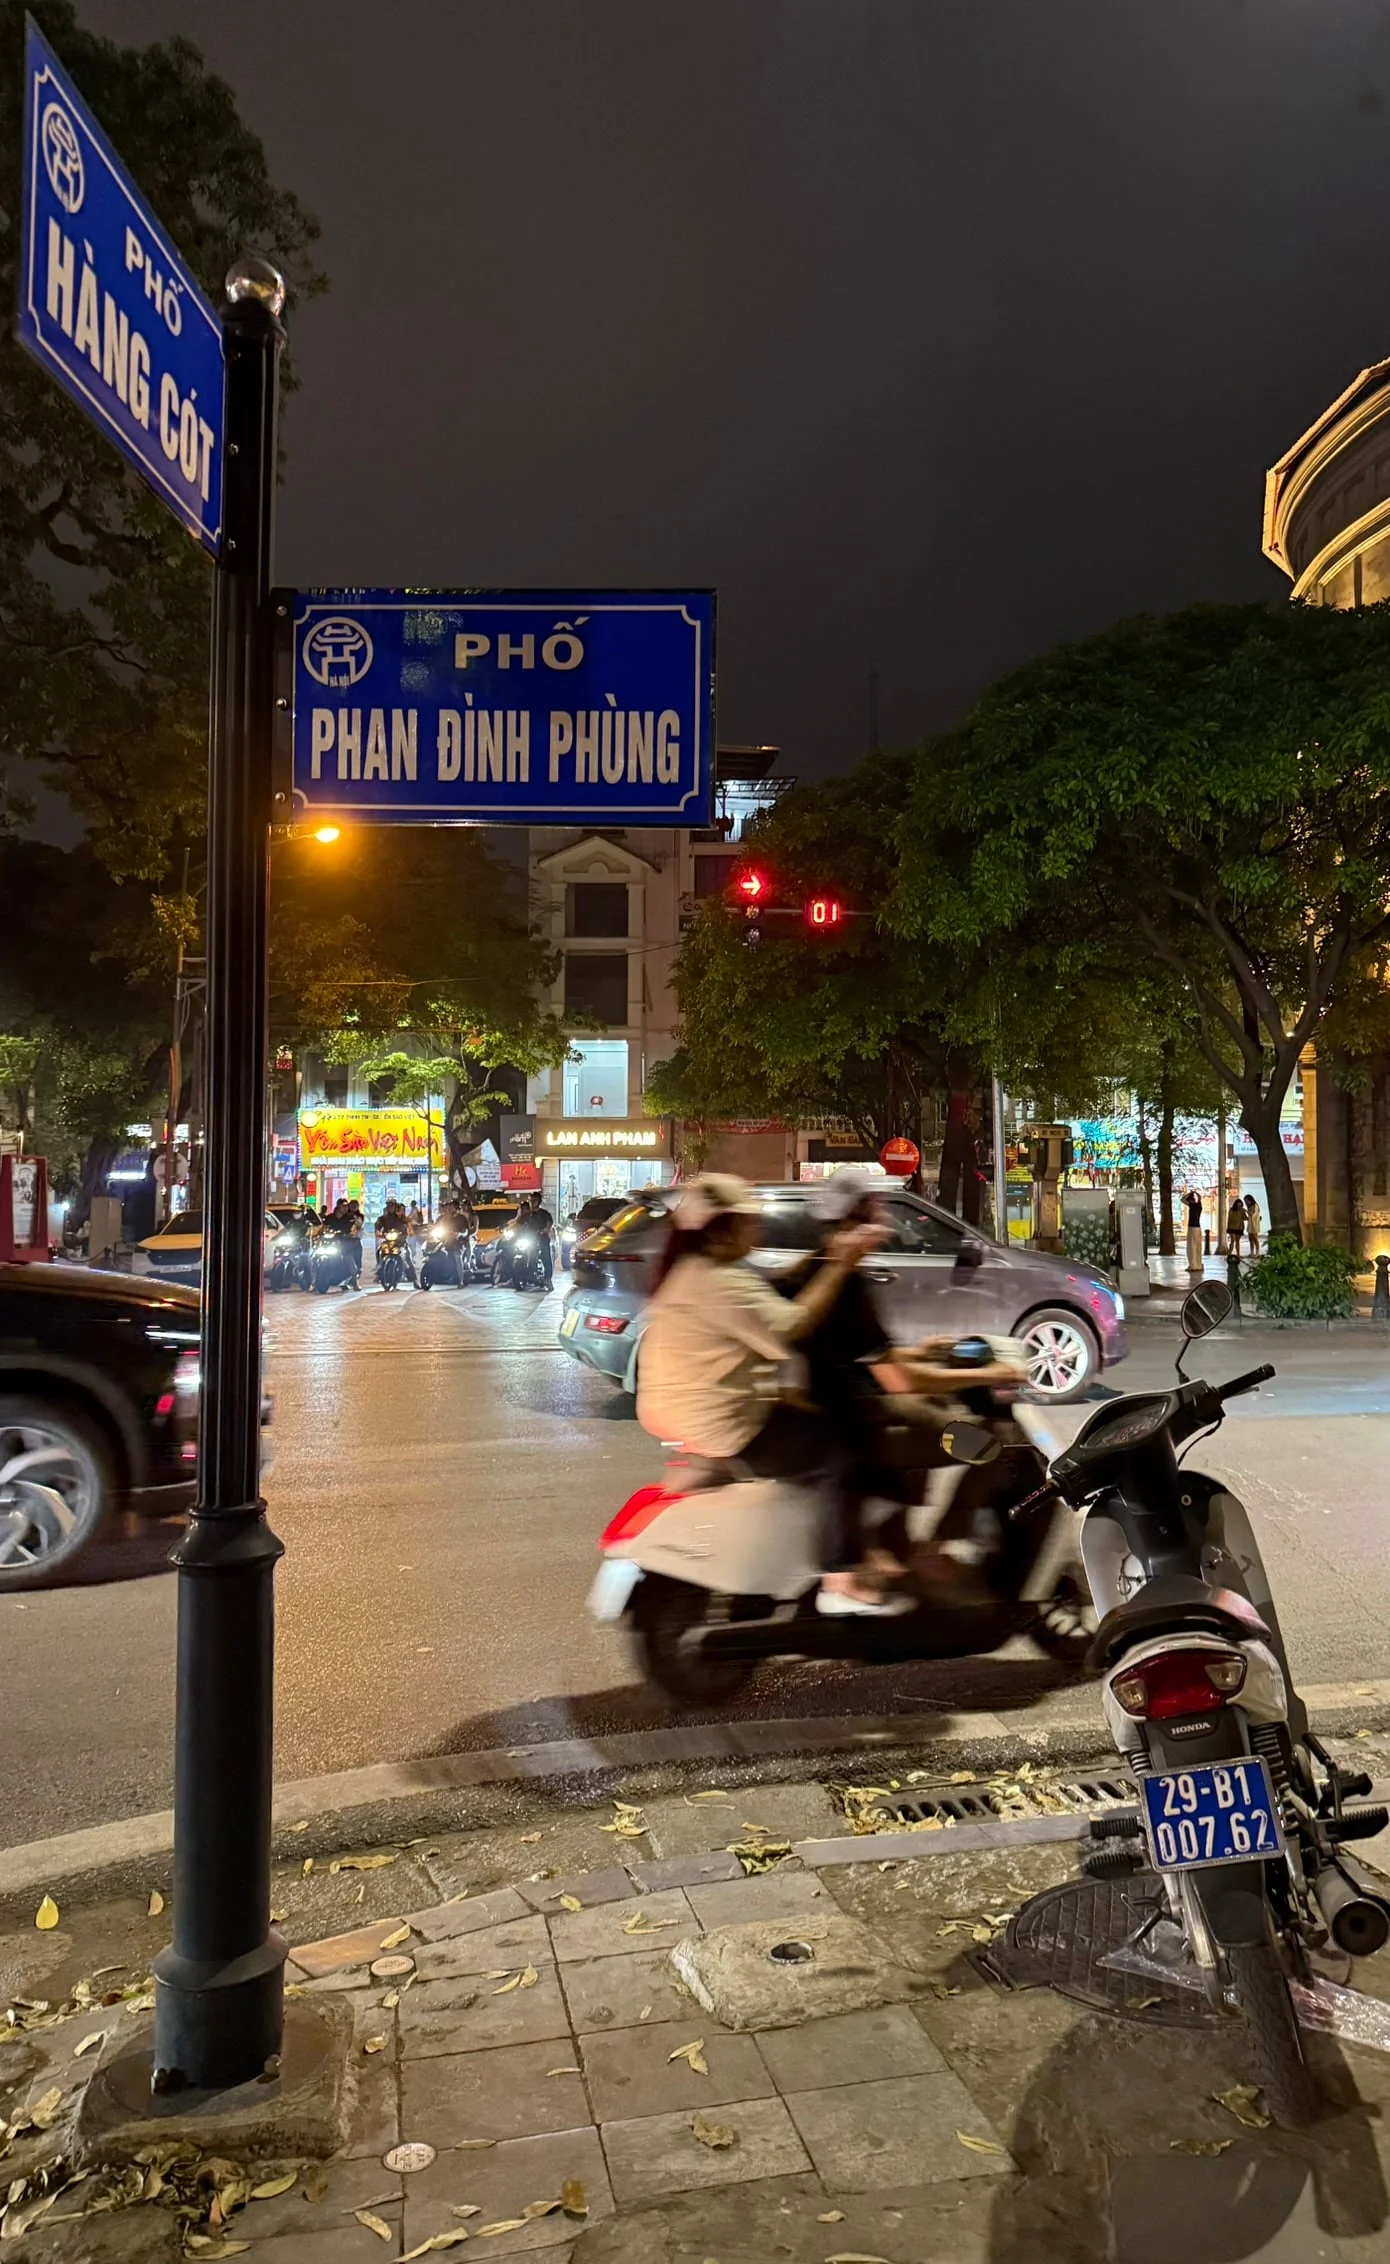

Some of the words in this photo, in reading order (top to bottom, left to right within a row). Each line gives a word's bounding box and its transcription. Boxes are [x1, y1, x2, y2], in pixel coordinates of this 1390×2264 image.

[125, 225, 184, 337] PHỐ
[47, 216, 150, 431] HÀNG
[159, 372, 214, 503] CÓT
[454, 616, 590, 671] PHỐ
[311, 708, 417, 781] PHAN
[437, 692, 530, 783] ĐÌNH
[548, 693, 679, 784] PHÙNG
[812, 902, 838, 923] 01
[546, 1131, 578, 1146] LAN
[579, 1131, 611, 1146] ANH
[1171, 1721, 1212, 1736] HONDA
[1159, 1766, 1252, 1817] 29-B1
[1156, 1809, 1274, 1864] 007.62
